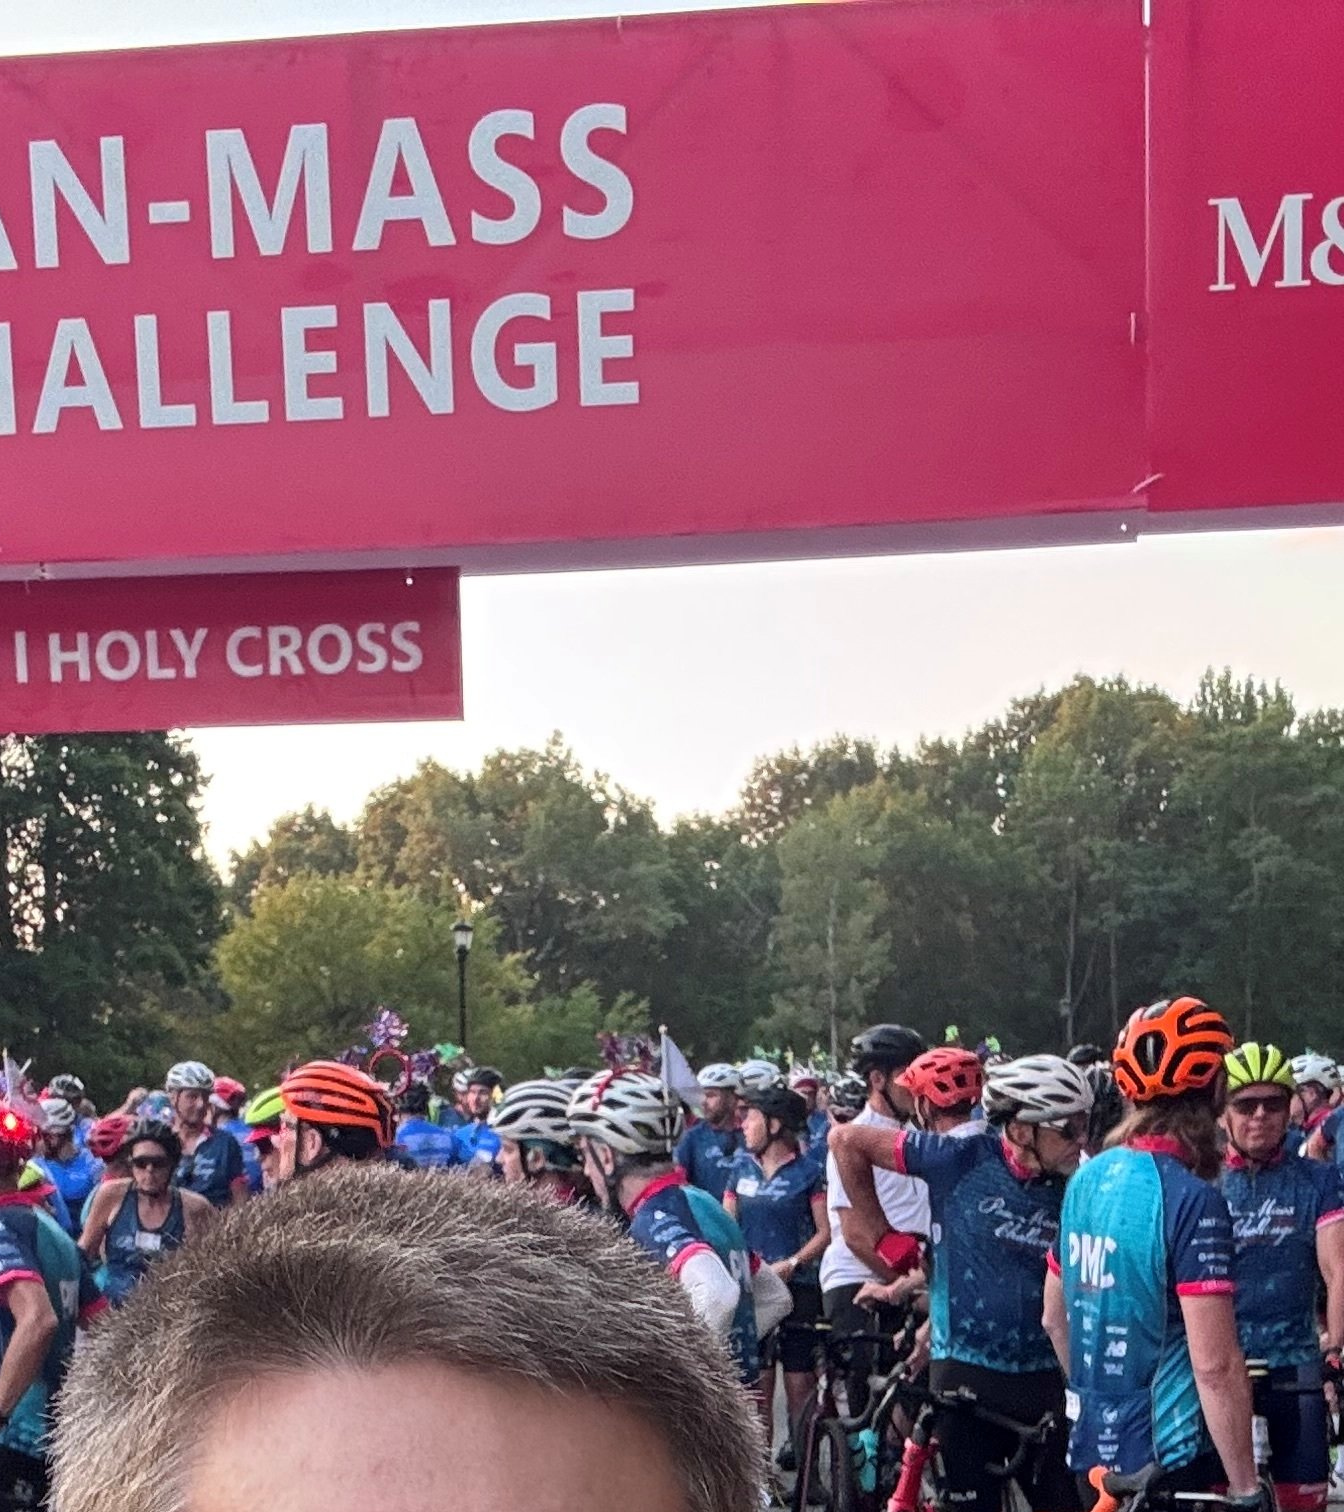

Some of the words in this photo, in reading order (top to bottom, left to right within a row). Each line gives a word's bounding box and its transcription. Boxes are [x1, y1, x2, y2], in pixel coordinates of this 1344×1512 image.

[48, 626, 208, 684] HOLY
[225, 620, 424, 678] CROSS
[1069, 1232, 1117, 1289] PMC
